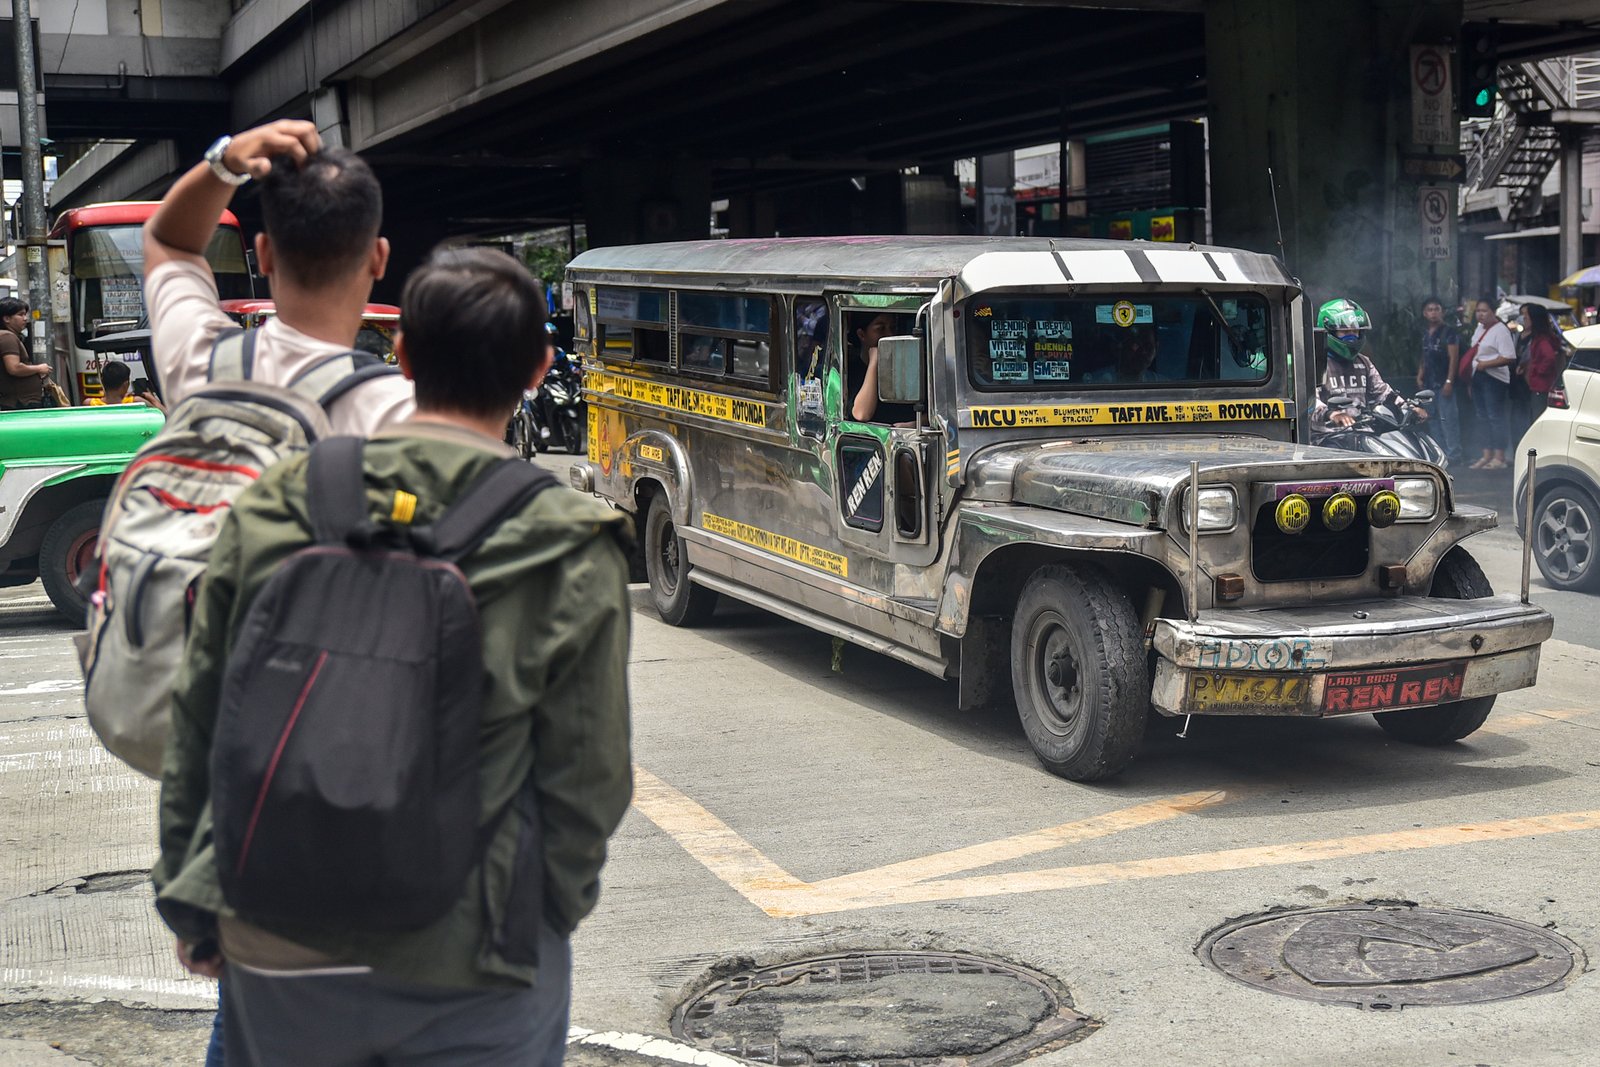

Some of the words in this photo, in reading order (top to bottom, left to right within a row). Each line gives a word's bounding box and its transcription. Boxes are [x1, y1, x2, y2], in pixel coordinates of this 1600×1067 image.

[1423, 101, 1440, 111] NO
[1418, 114, 1444, 125] LEFT
[1418, 130, 1448, 142] TURN
[1430, 227, 1442, 235] NO
[1434, 237, 1440, 246] U
[1425, 248, 1448, 257] TURN
[992, 321, 1027, 331] BUENDIA
[1035, 363, 1051, 376] SM
[615, 377, 632, 397] MCU
[666, 388, 680, 408] TAFT
[732, 399, 764, 425] ROTONDA
[1053, 408, 1100, 416] BLUMENTRITT
[1109, 405, 1142, 423] TAFT
[1145, 405, 1172, 422] AVE.
[1218, 402, 1281, 419] ROTONDA
[973, 409, 1016, 426] MCU
[1036, 416, 1049, 424] AVE.
[847, 476, 866, 516] REN
[862, 450, 883, 490] REN
[1340, 483, 1376, 493] BEAUTY
[1327, 675, 1361, 687] LADY
[1366, 673, 1397, 684] BOSS
[1326, 683, 1395, 711] REN
[1400, 675, 1462, 704] REN
